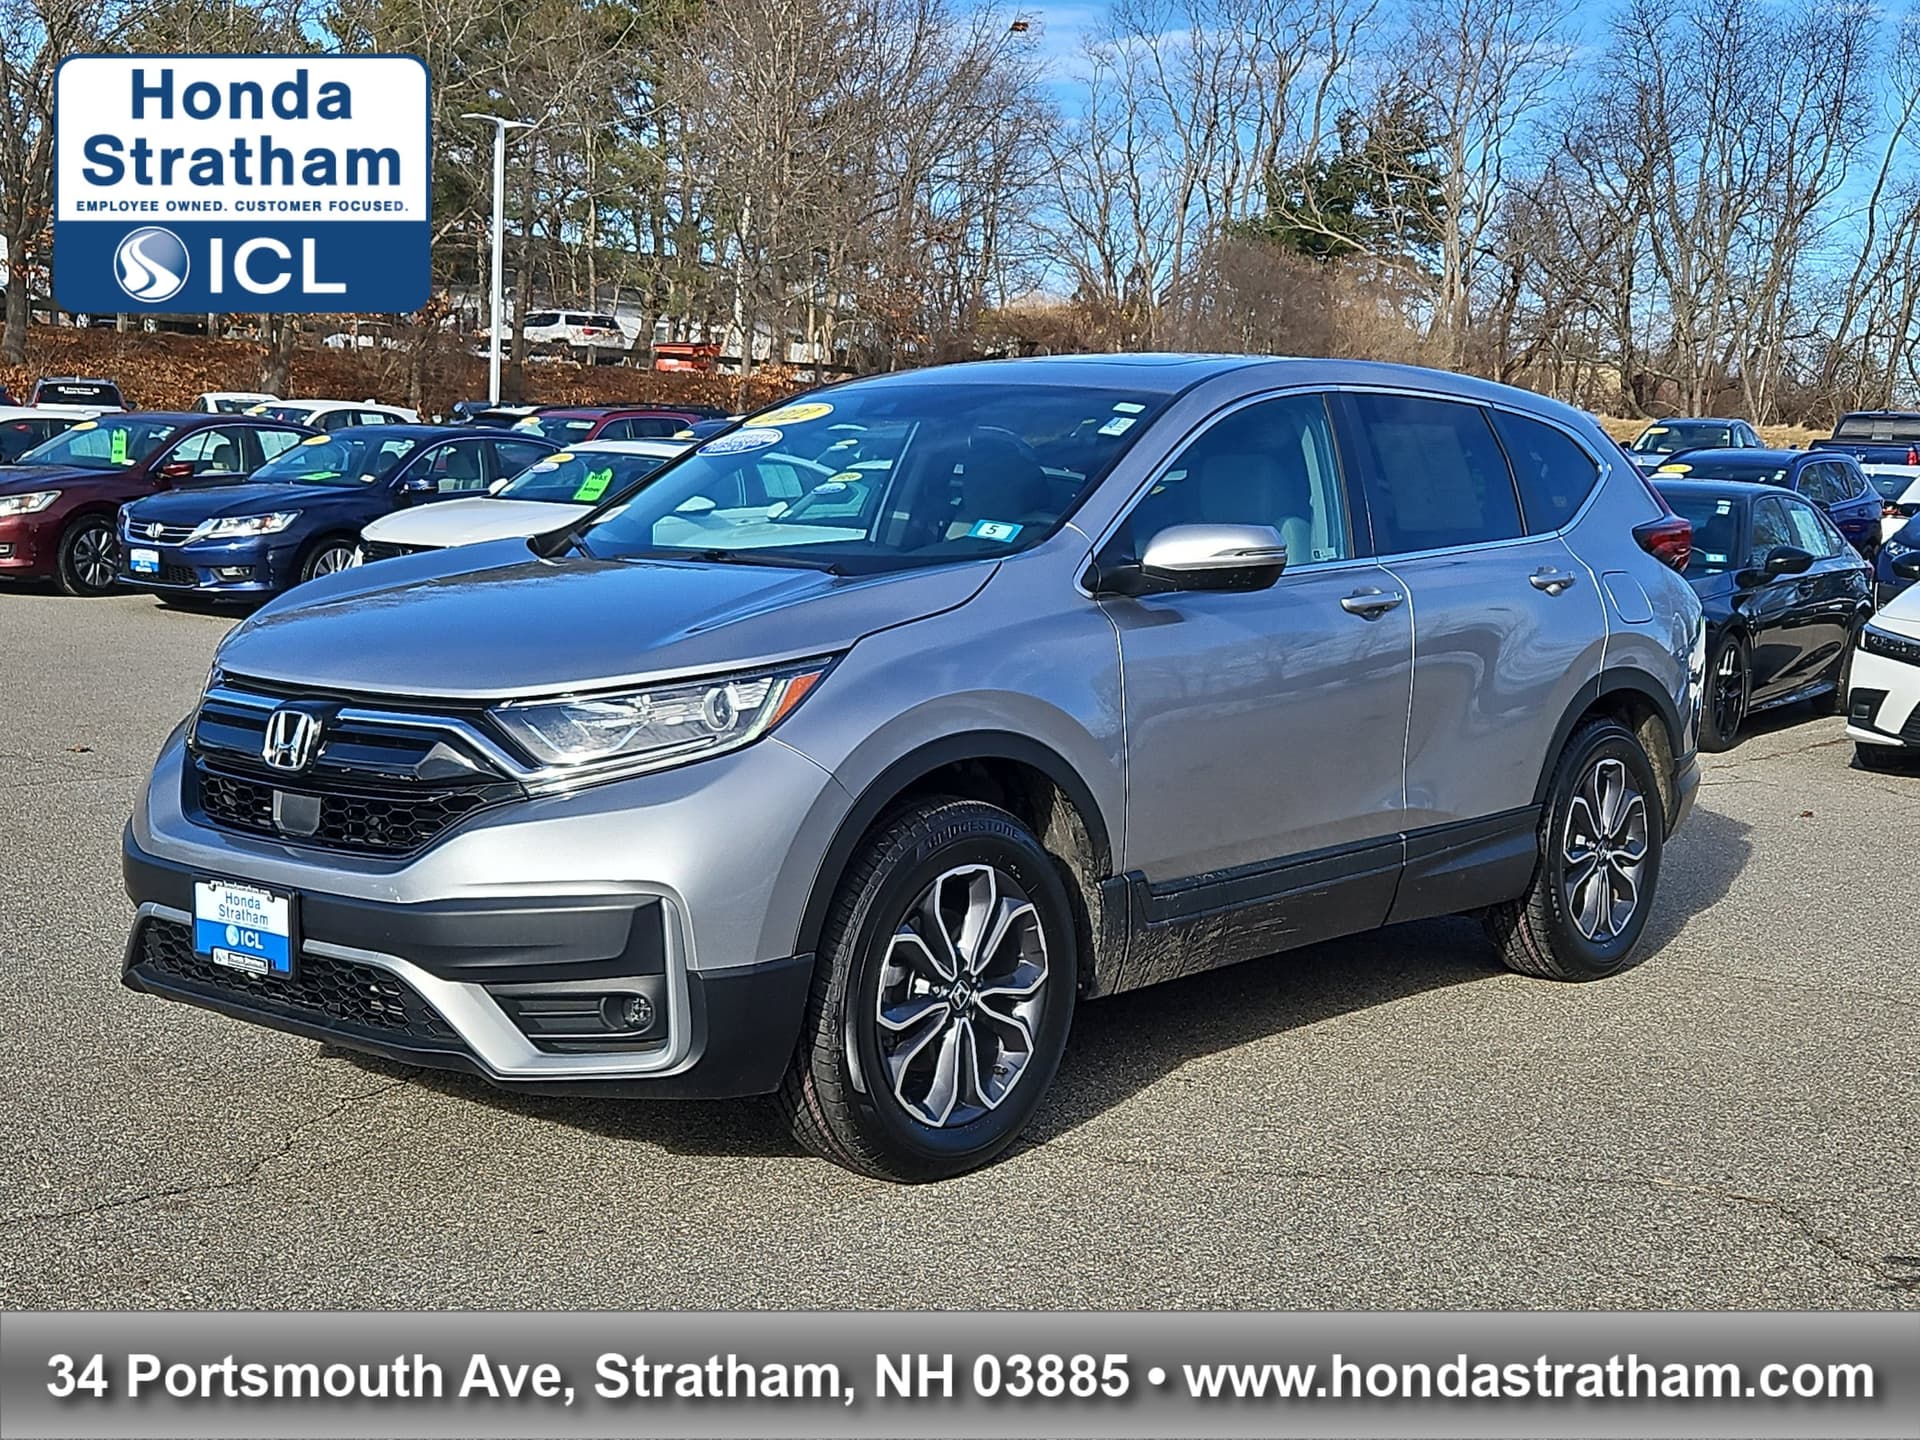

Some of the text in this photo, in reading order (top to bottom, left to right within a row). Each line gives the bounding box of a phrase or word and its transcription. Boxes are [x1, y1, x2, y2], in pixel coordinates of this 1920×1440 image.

[985, 524, 1000, 535] 5
[225, 890, 261, 910] Honda
[218, 903, 269, 926] Stratham
[240, 929, 264, 949] ICL
